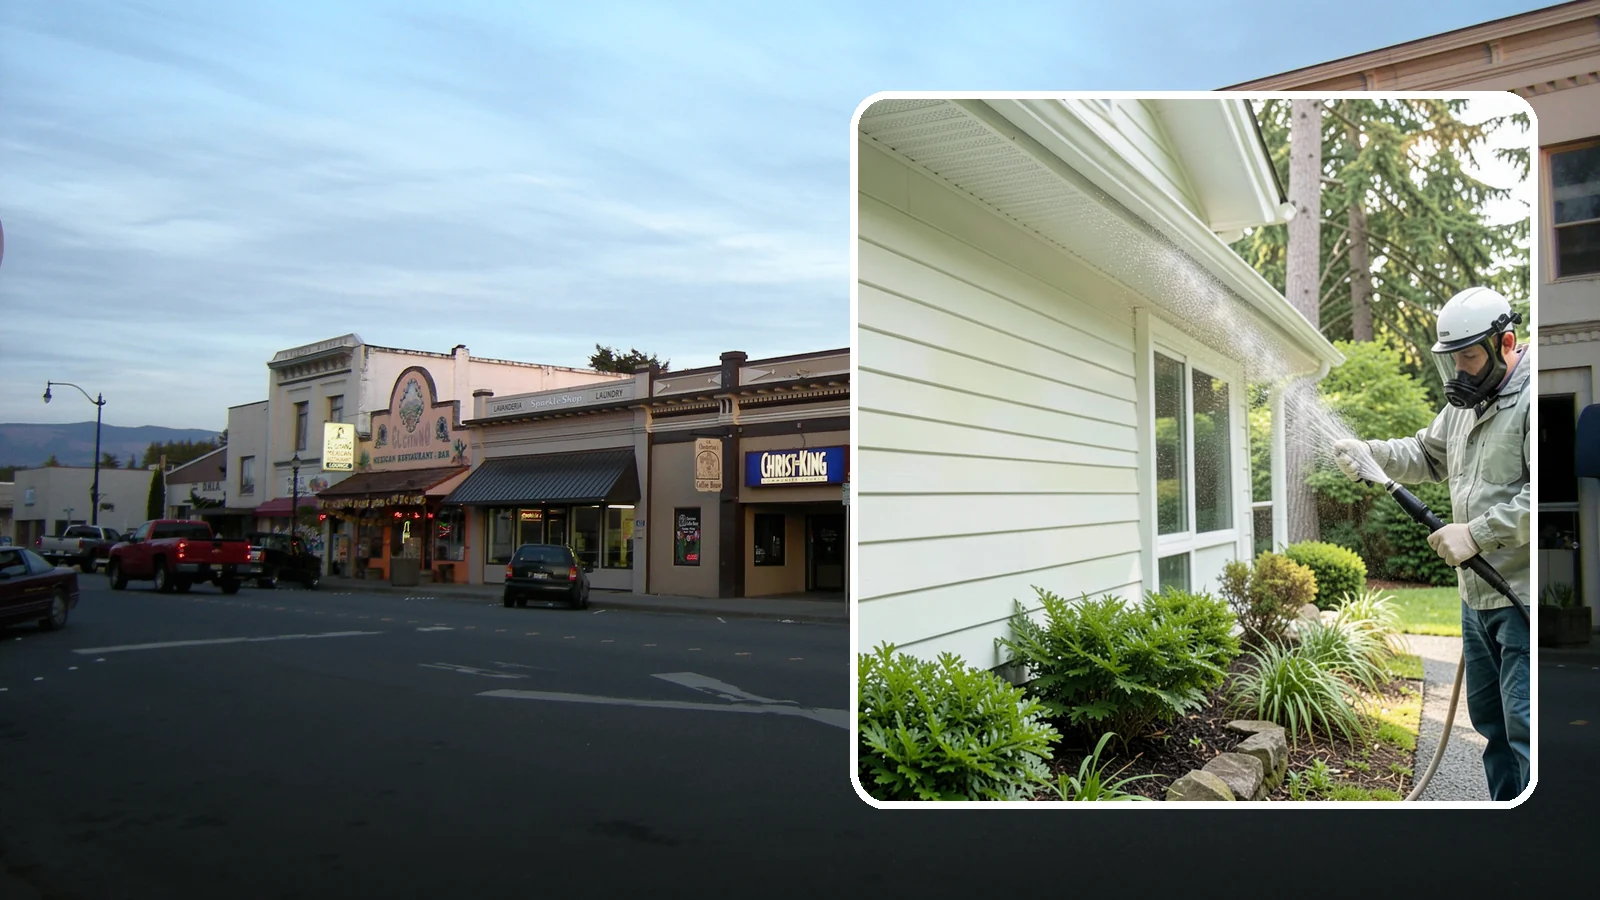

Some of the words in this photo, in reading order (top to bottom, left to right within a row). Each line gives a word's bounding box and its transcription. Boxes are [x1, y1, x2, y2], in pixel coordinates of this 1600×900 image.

[531, 396, 560, 409] Sparkle
[562, 394, 582, 405] Shop
[595, 389, 624, 400] LAUNDRY
[493, 402, 522, 412] LAVANDERIA
[373, 454, 396, 464] MEXICAN
[397, 451, 433, 463] RESTAURANT
[438, 450, 450, 459] BAR
[761, 452, 797, 478] CHRIST
[799, 450, 827, 476] KING
